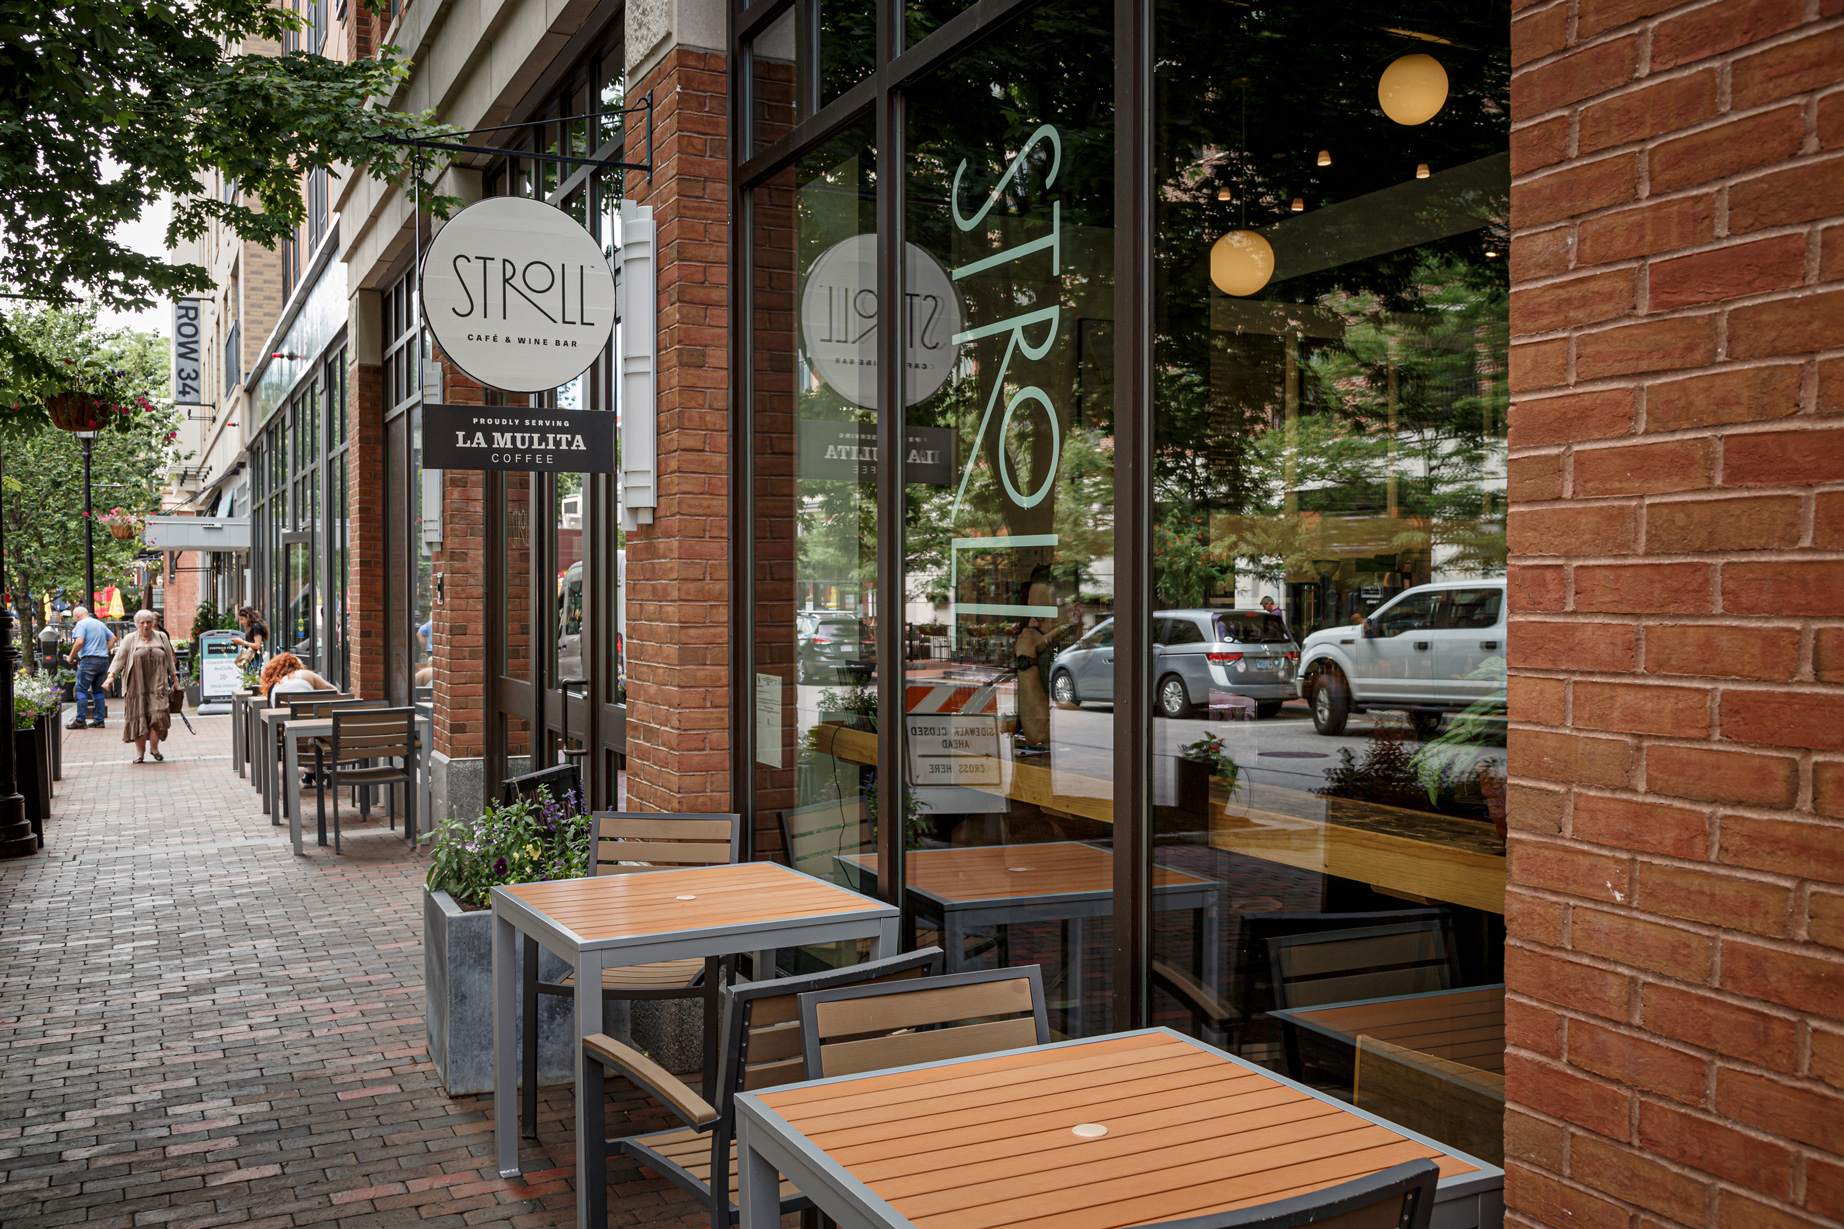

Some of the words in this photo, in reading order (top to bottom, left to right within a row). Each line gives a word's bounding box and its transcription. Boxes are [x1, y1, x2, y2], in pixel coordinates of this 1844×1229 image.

[451, 254, 595, 326] STROLL
[177, 305, 199, 362] ROW
[467, 333, 498, 343] CAFÉ
[517, 337, 548, 346] WINE
[555, 339, 578, 348] BAR
[178, 367, 199, 397] 34
[951, 123, 1060, 651] STROLL
[472, 417, 519, 426] PROUDLY
[525, 419, 570, 427] SERVING
[455, 431, 488, 448] LA
[492, 432, 587, 450] MULITA
[491, 453, 554, 464] COFFEE
